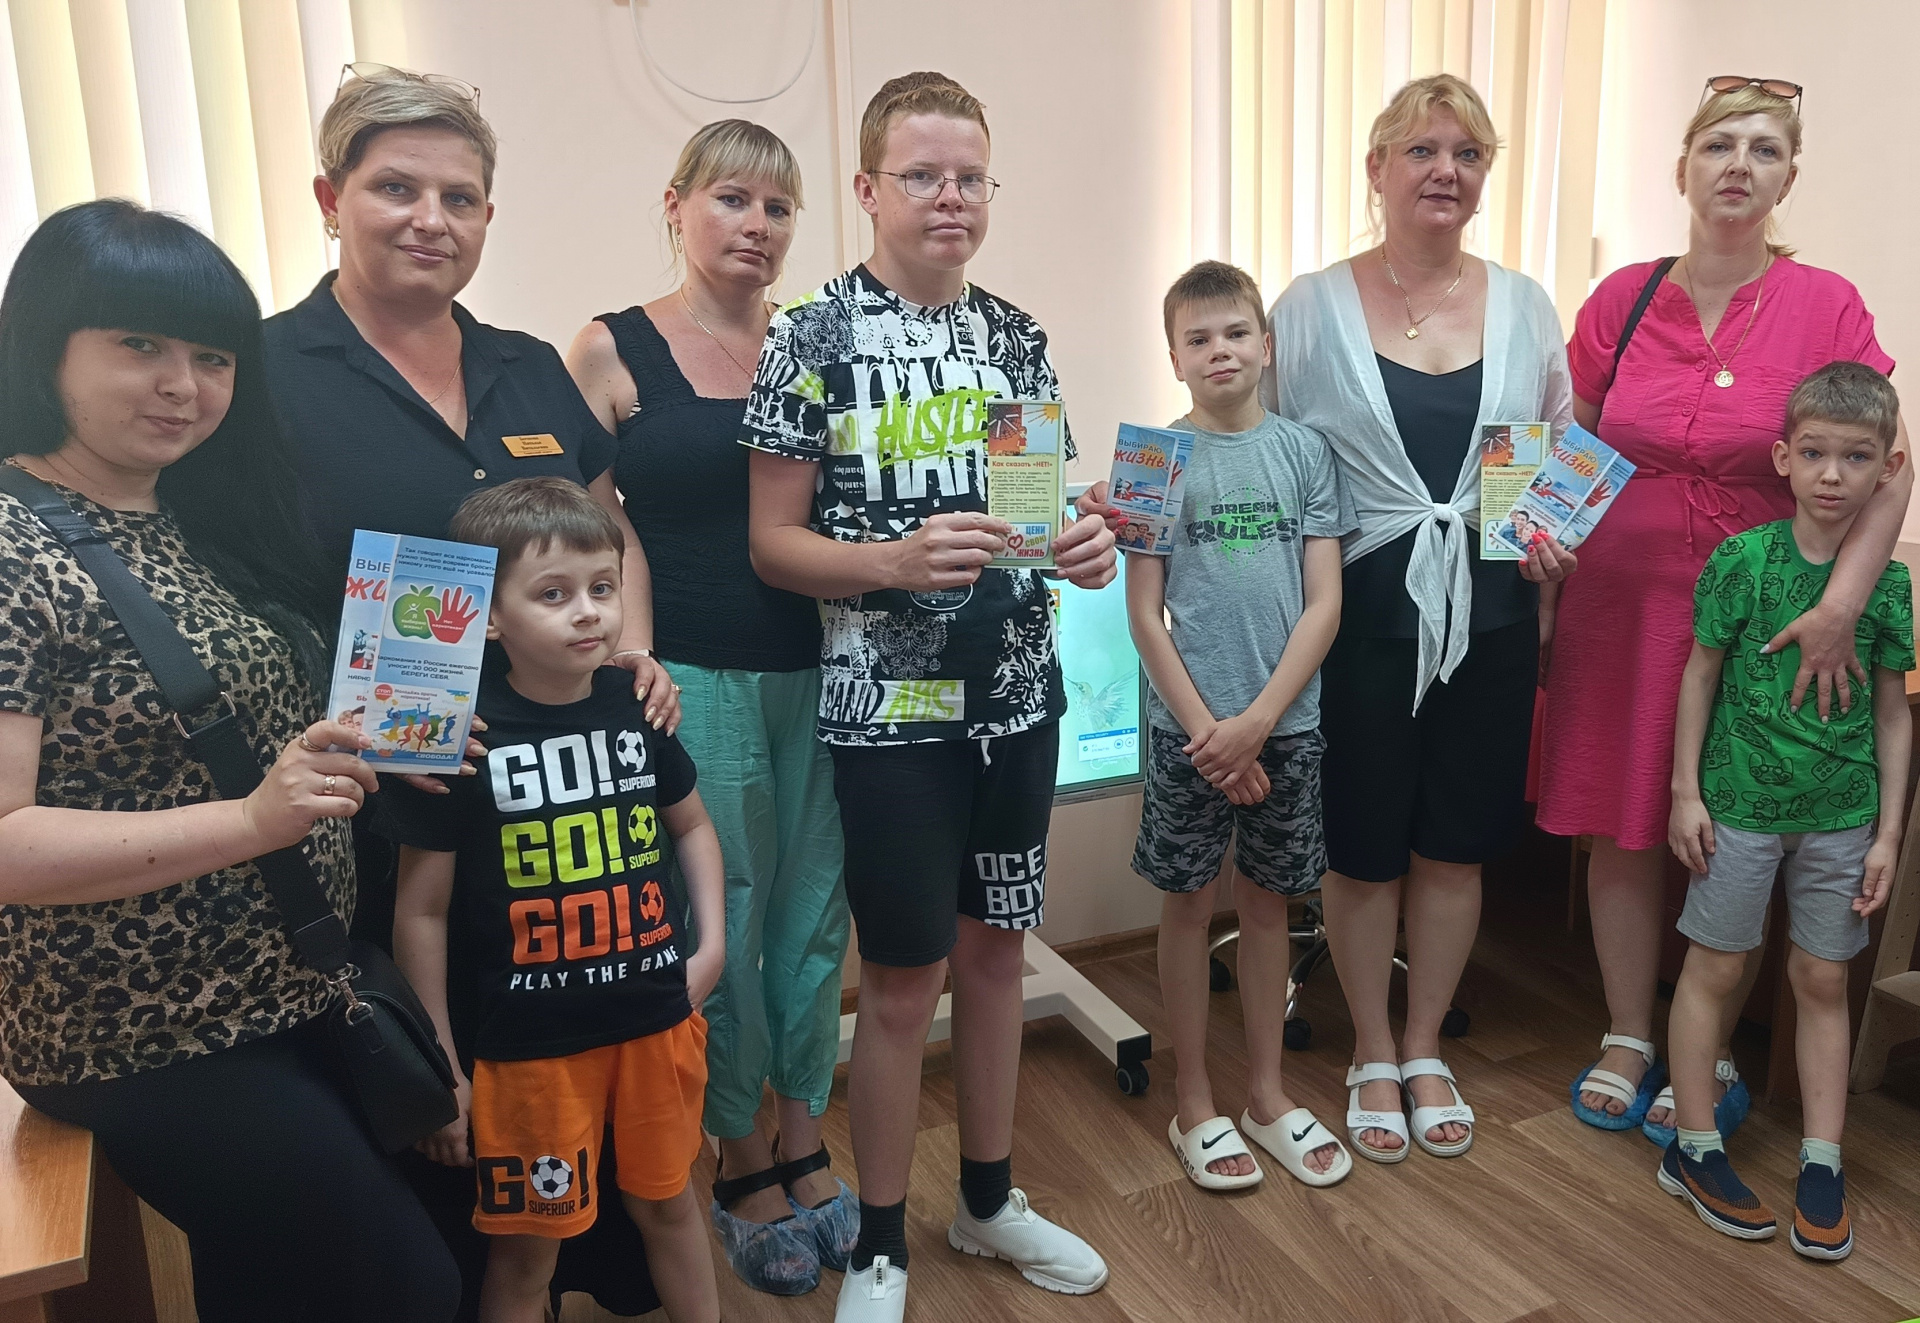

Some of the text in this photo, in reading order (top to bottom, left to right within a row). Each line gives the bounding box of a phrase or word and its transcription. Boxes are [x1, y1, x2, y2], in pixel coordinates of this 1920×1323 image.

[1118, 438, 1163, 454] ВЫБИРАЮ
[1231, 514, 1261, 523] THE
[1026, 526, 1046, 536] ЦЕНИ
[1185, 517, 1299, 547] RULES
[1025, 535, 1047, 547] СВОЮ
[417, 549, 442, 557] говорят
[1016, 549, 1044, 557] ЖИЗНЬ
[401, 670, 428, 678] БЕРЕГИ
[449, 663, 479, 671] ежегодно
[415, 753, 454, 762] СВОБОДА!
[488, 729, 616, 812] GO!
[618, 774, 656, 793] SUPERIOR
[501, 806, 625, 888] GO!
[510, 884, 634, 965] GO!
[510, 945, 679, 990] PLAY THE GAME
[528, 1200, 576, 1216] SUPERIOR
